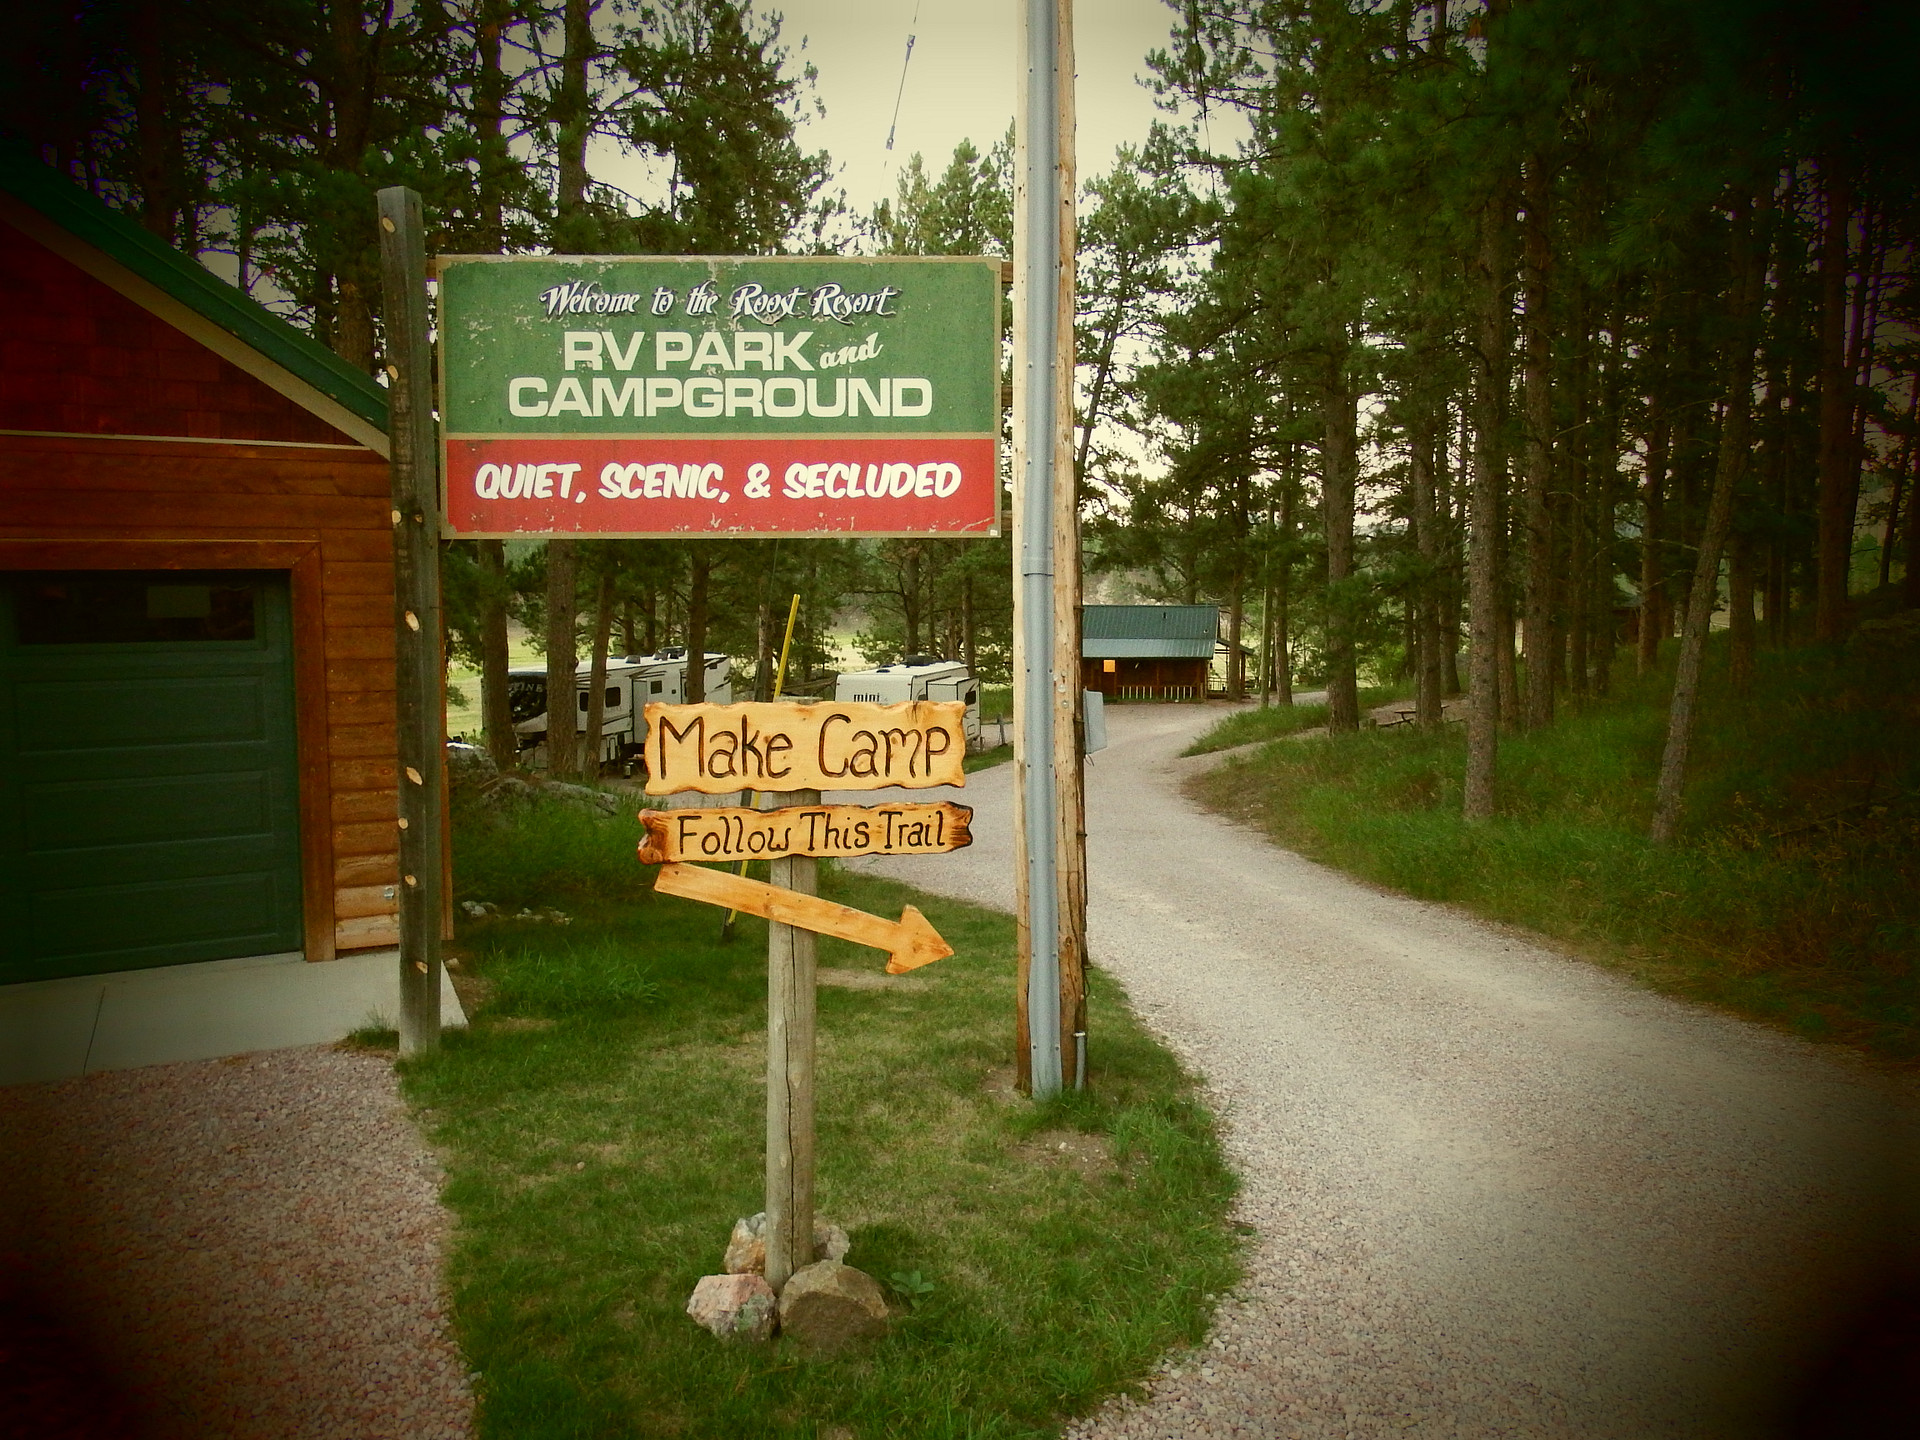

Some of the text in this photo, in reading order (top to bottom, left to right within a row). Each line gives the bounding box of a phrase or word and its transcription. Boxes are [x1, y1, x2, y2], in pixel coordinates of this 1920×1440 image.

[540, 279, 901, 325] Welcome to the Roost Resort
[564, 331, 884, 372] RV PARK and
[508, 377, 932, 418] CAMPGROUND
[474, 462, 962, 503] QUIET, SCENIC, & SECLUDED
[853, 692, 880, 702] mini
[659, 714, 950, 780] Make Camp
[677, 811, 945, 854] Follow This Trail
